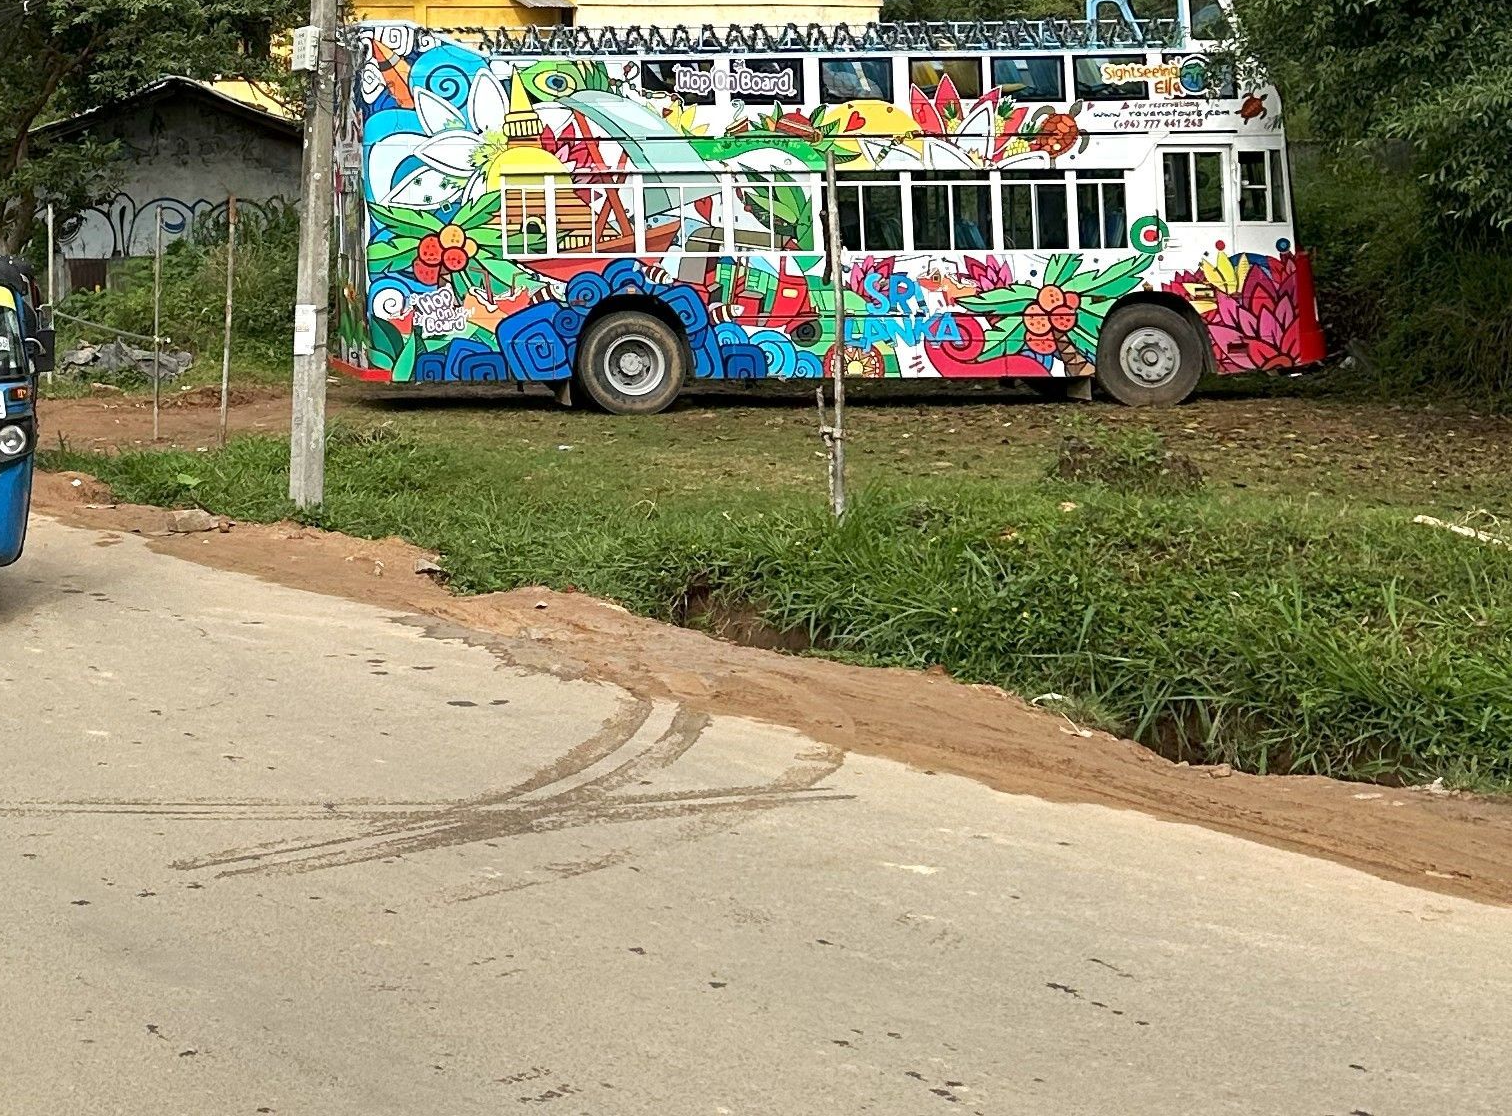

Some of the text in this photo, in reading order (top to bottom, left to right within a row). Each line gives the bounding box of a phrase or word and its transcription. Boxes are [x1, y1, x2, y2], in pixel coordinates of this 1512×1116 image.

[679, 69, 792, 92] Hop On Board
[1155, 77, 1184, 96] Ella
[1144, 120, 1162, 128] 777
[864, 272, 929, 315] SRI
[843, 312, 965, 352] LANKA
